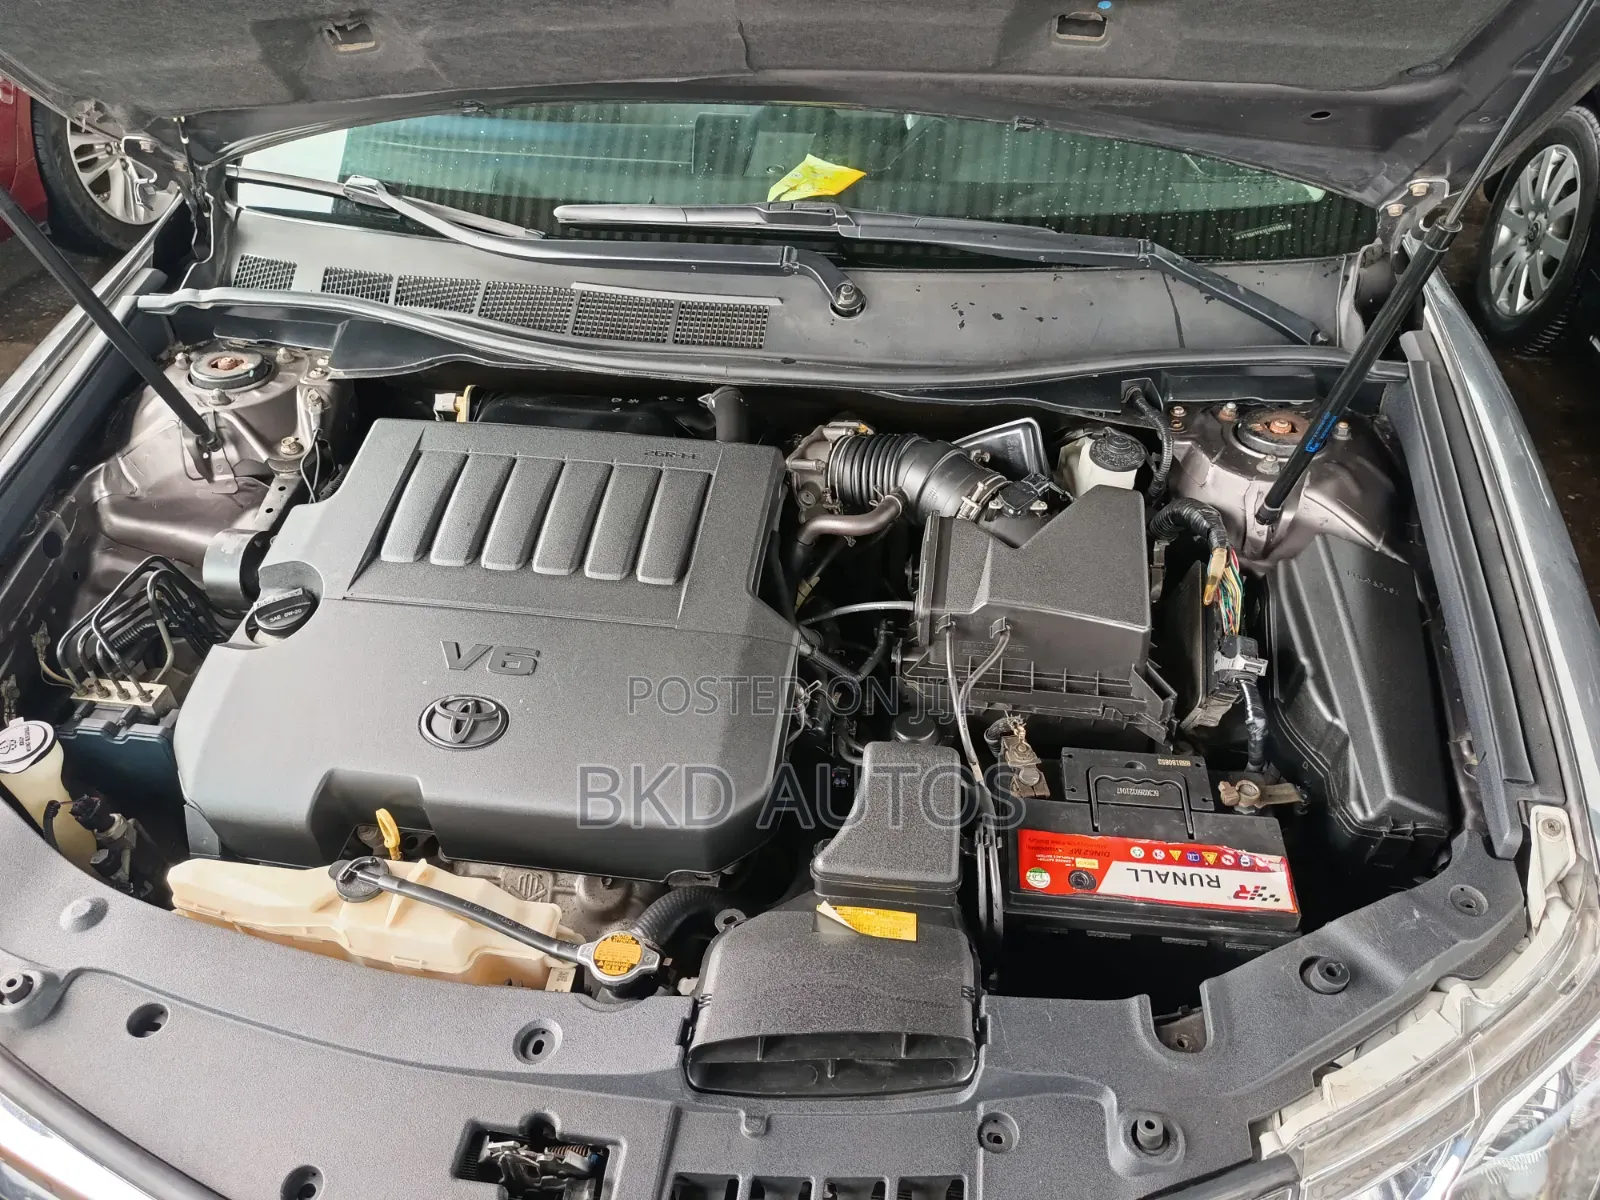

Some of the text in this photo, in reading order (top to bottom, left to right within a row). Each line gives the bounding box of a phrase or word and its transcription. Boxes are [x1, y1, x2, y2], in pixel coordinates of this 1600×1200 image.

[269, 608, 302, 623] SAE 0W-20
[440, 640, 541, 676] V6
[1126, 867, 1221, 889] RUNALL
